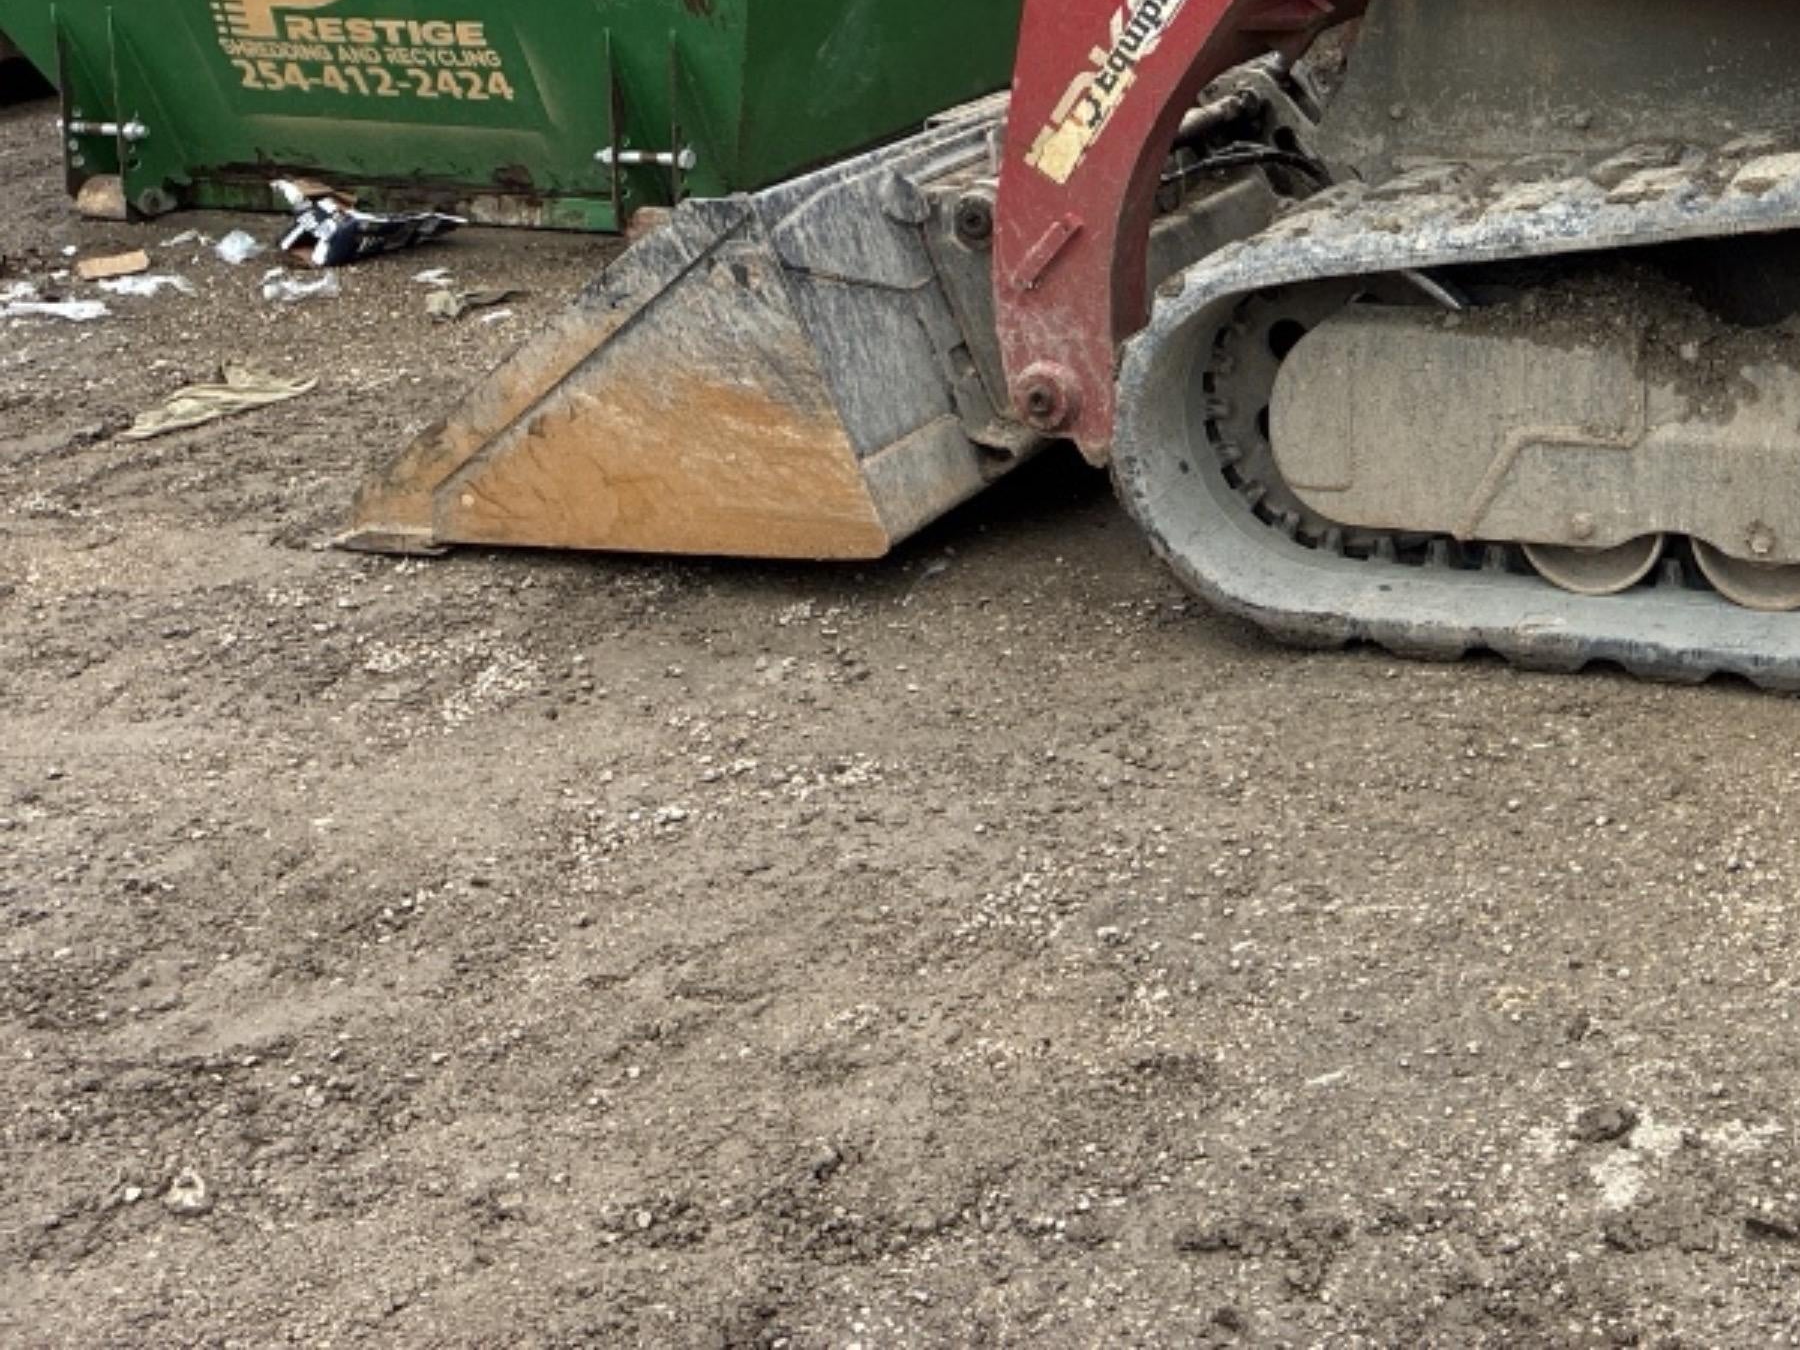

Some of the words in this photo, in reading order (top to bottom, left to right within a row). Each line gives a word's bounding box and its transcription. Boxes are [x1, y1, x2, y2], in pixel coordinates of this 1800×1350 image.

[223, 38, 334, 62] SHREDDING
[338, 46, 380, 65] AND
[384, 47, 501, 67] RECYCLING
[231, 59, 515, 101] 254-412-2424
